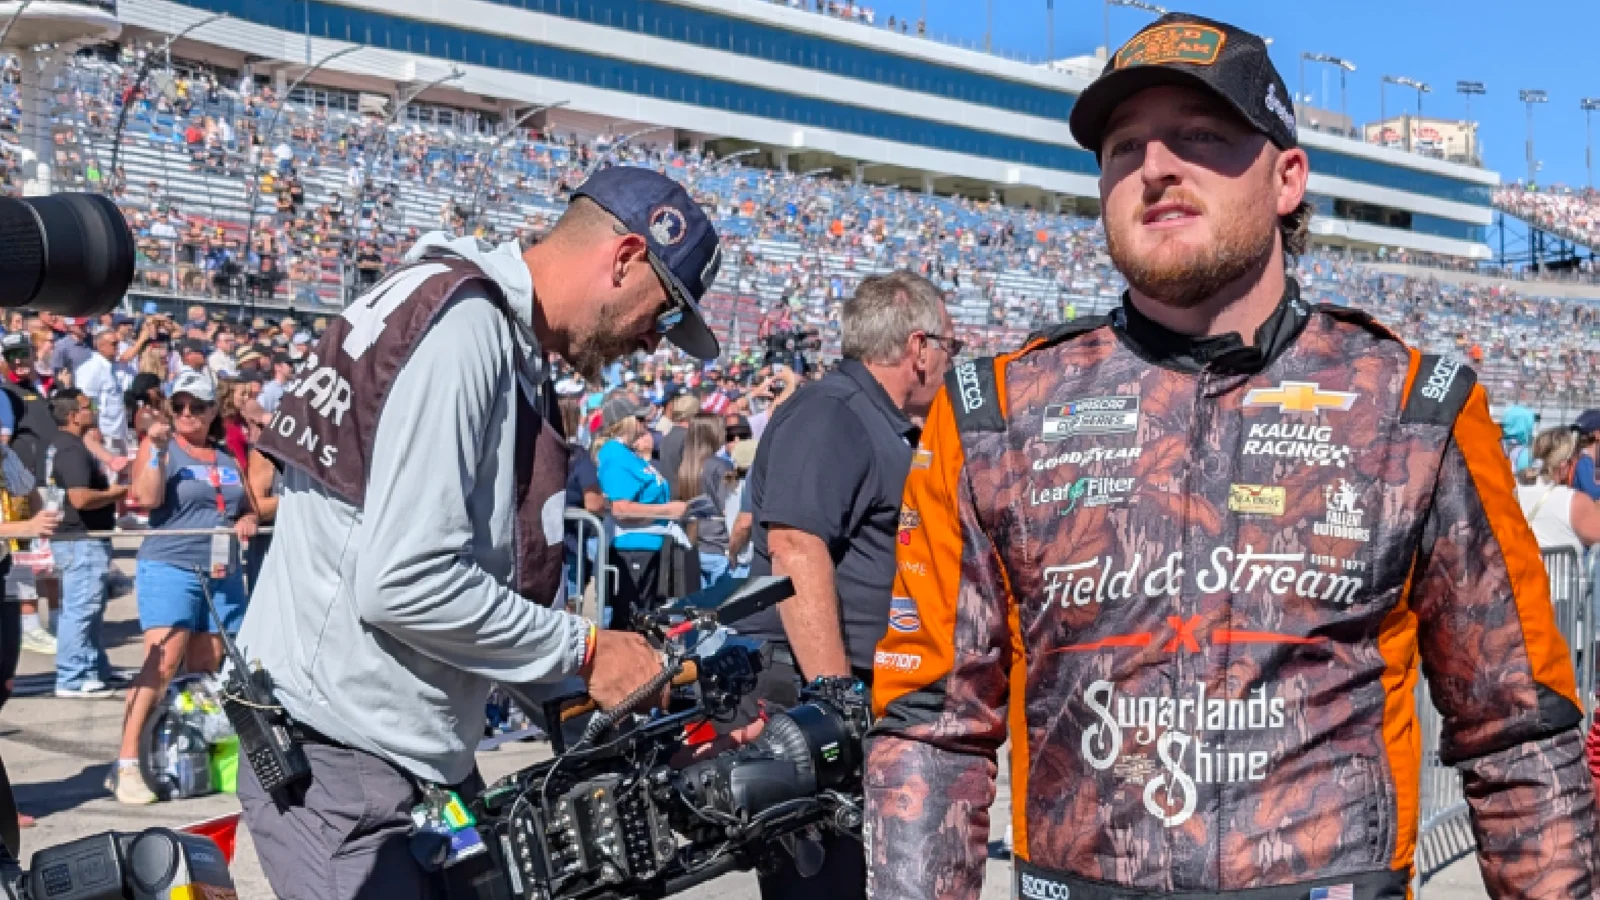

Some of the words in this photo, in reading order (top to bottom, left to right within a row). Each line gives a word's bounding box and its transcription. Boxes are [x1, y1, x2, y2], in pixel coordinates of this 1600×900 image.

[1242, 440, 1330, 460] RACING
[1249, 423, 1333, 442] KAULIG
[1032, 447, 1142, 470] GOODYEAR
[1040, 553, 1142, 613] Field
[1144, 551, 1187, 597] &
[1195, 544, 1364, 605] Stream
[1081, 679, 1285, 770] Sugarlands
[1143, 731, 1268, 828] Shine
